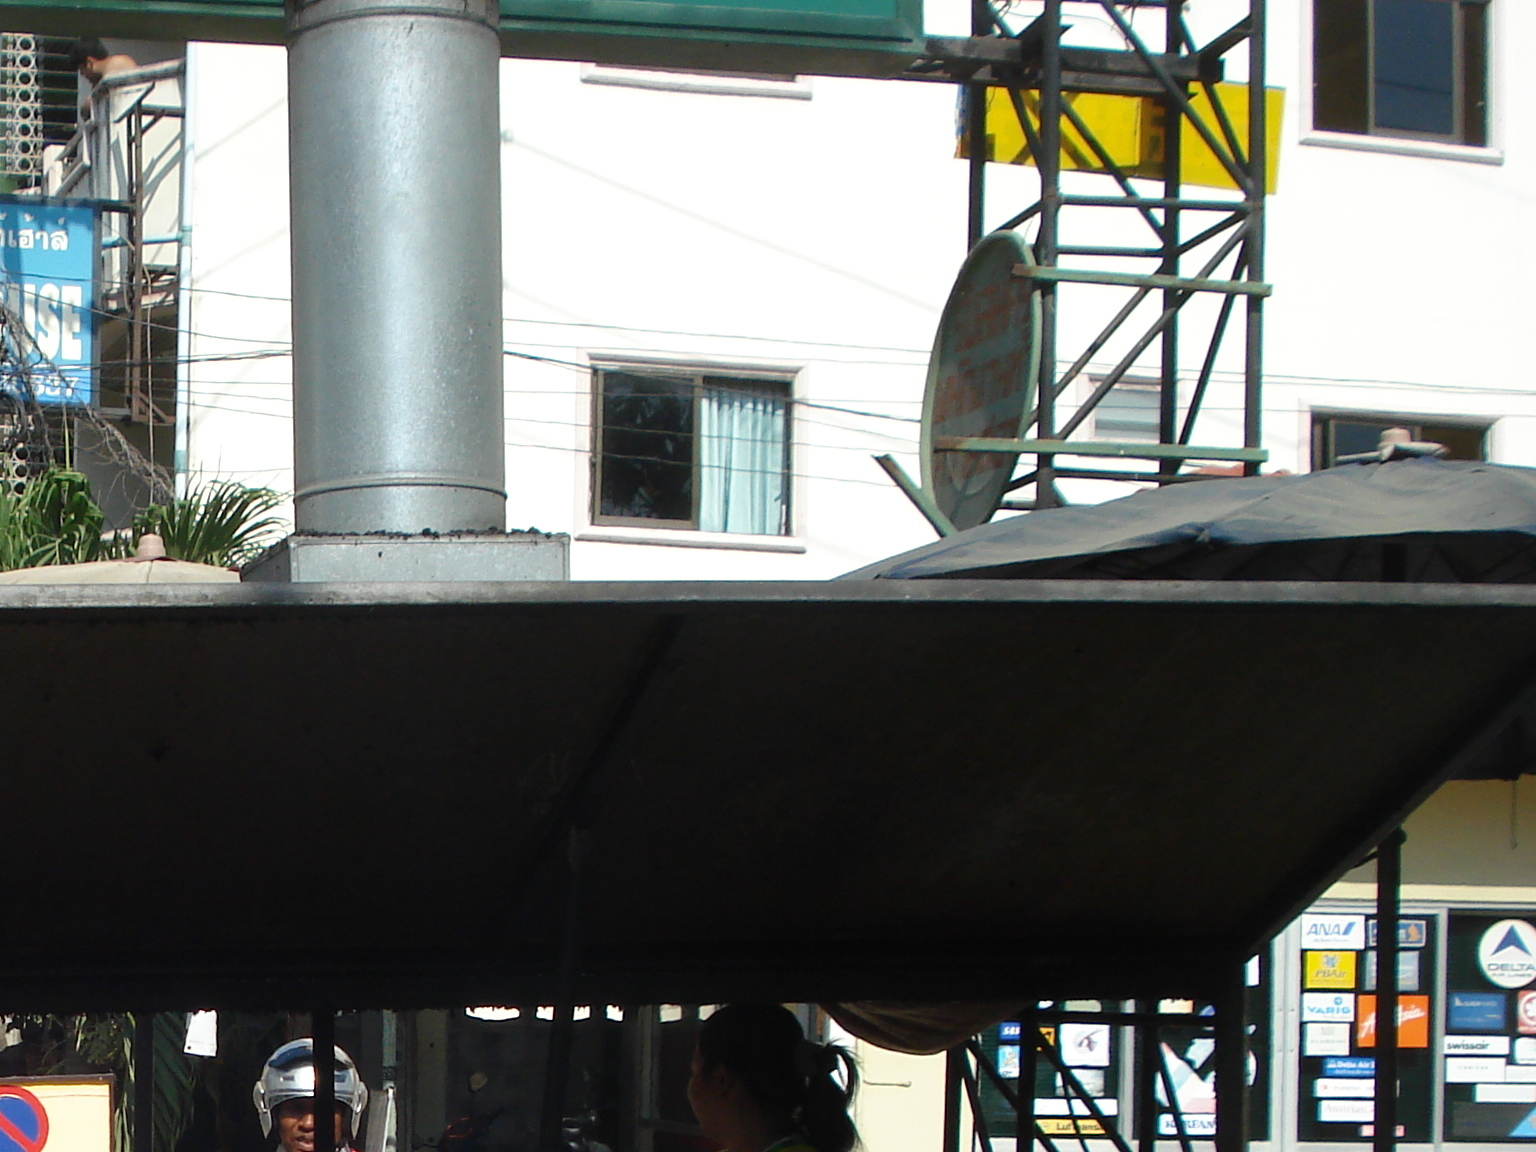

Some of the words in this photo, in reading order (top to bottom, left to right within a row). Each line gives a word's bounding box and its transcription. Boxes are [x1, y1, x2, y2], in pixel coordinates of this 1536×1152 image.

[1306, 922, 1342, 936] ANA
[1487, 963, 1535, 972] DELTA
[1307, 1006, 1352, 1015] VARIG
[1446, 1040, 1490, 1051] swissair
[1336, 1060, 1358, 1069] Delta
[1164, 1119, 1215, 1130] KREAN
